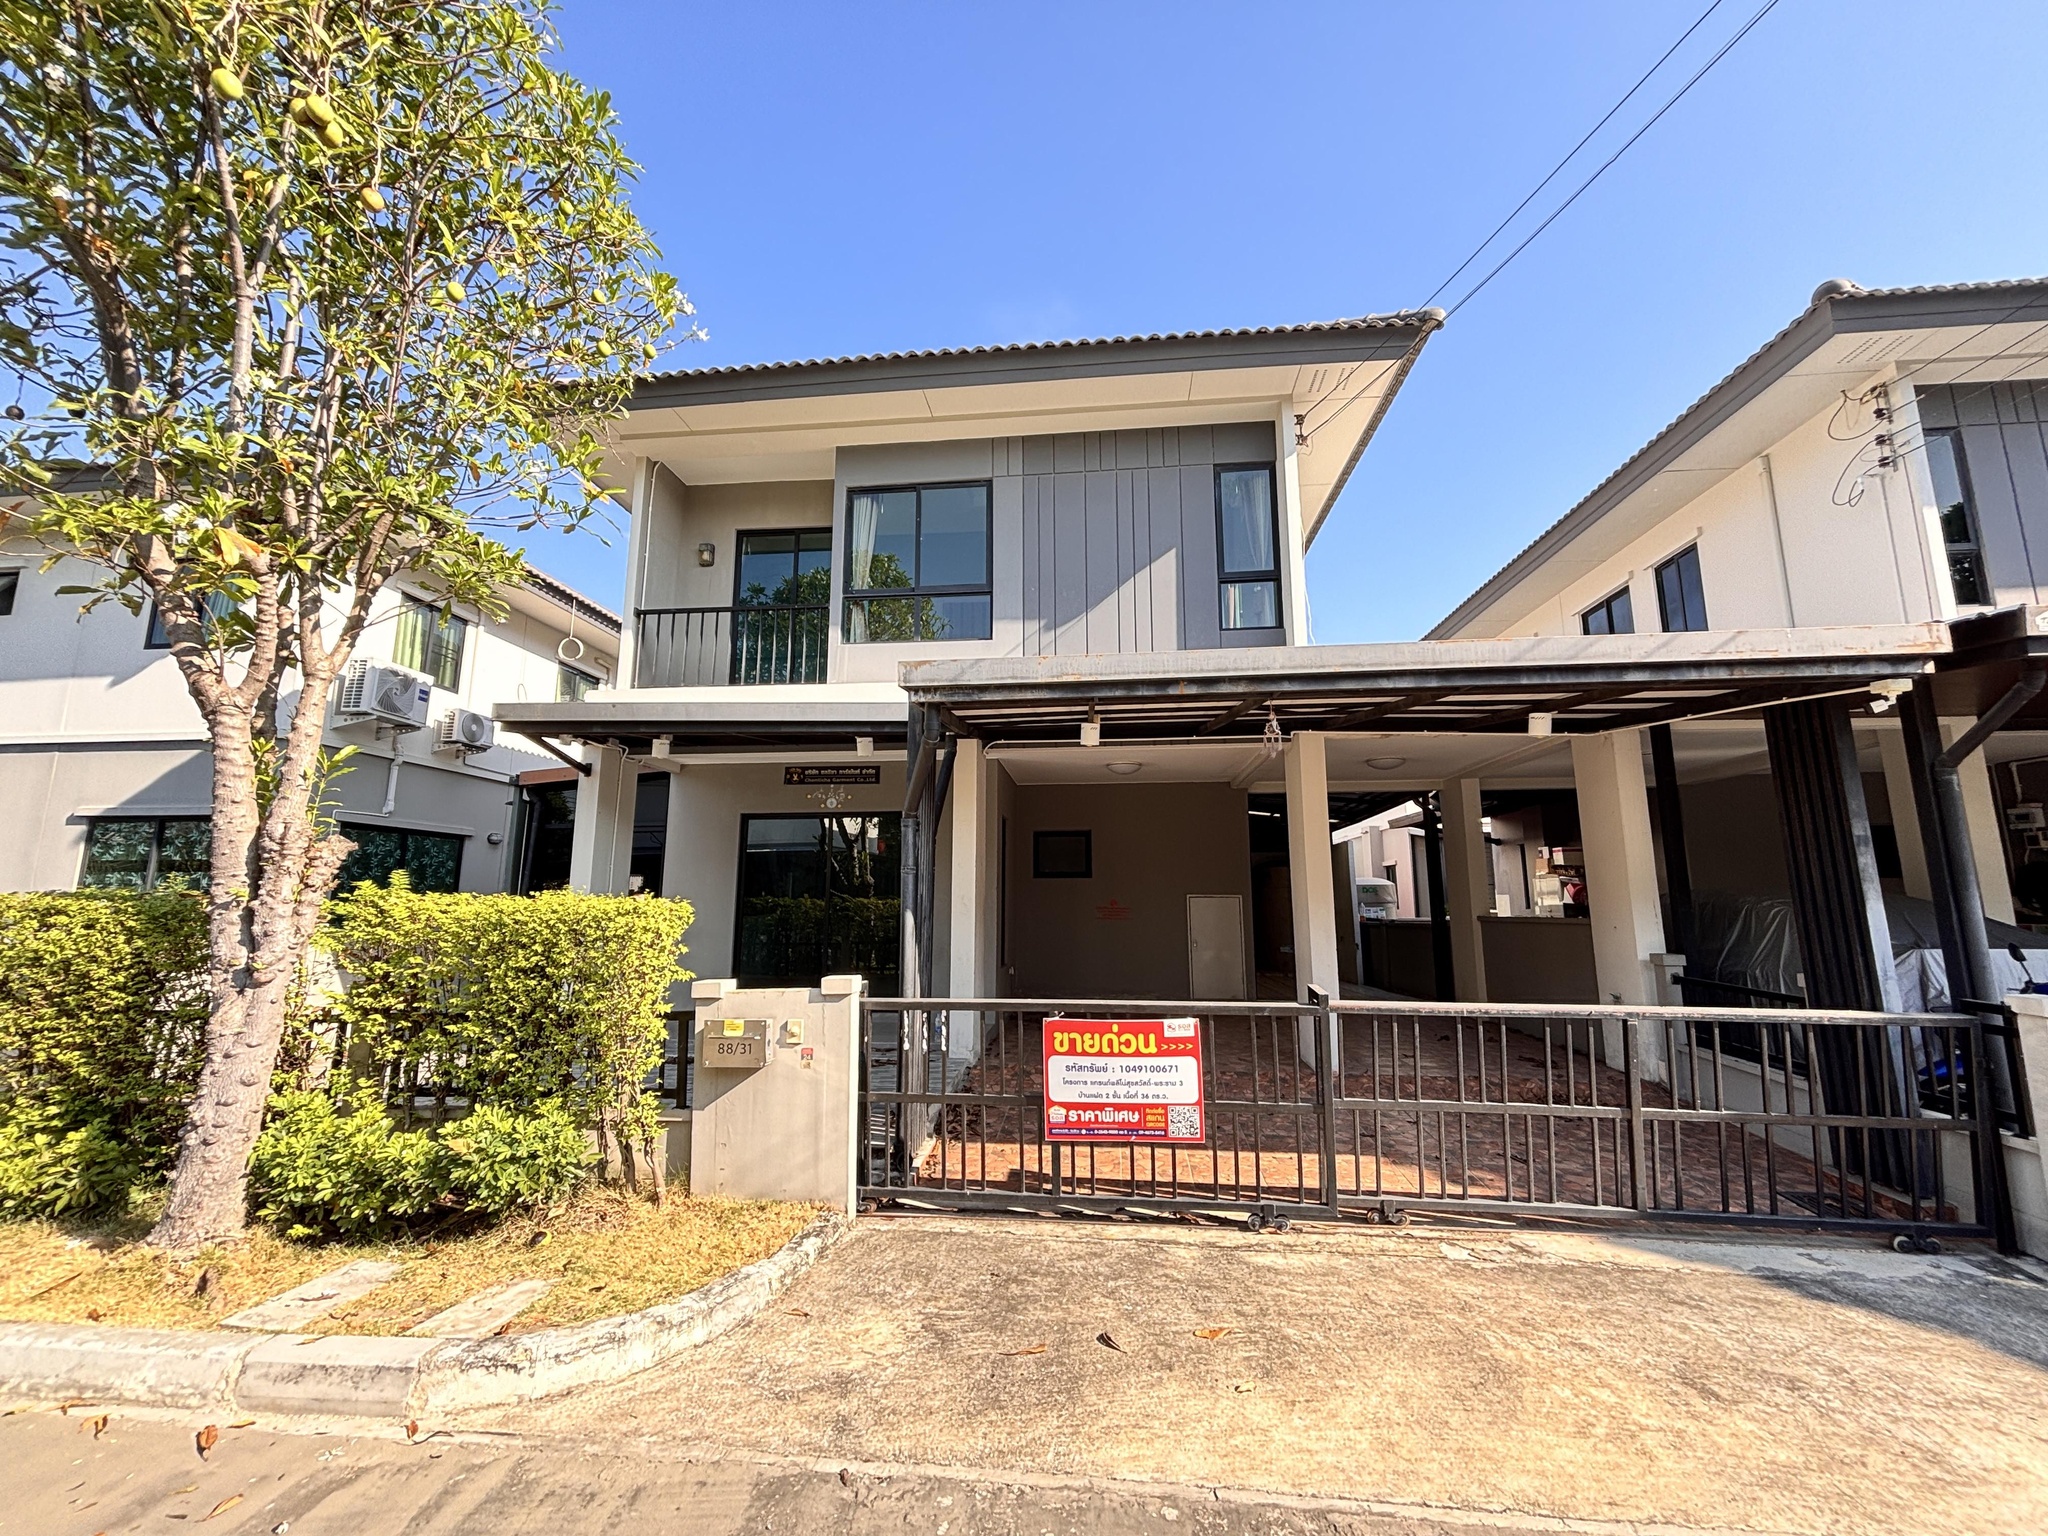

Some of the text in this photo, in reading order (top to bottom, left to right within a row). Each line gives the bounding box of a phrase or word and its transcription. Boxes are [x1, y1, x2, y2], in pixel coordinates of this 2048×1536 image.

[1053, 1023, 1158, 1054] ขายด่วน
[717, 1042, 752, 1056] 88/31
[1065, 1063, 1108, 1073] รหัสทรัพย์
[1119, 1064, 1179, 1073] 1049100671
[1062, 1077, 1088, 1086] โครงการ
[1077, 1090, 1103, 1099] บ้านแฝด
[1111, 1090, 1121, 1099] ชั้น
[1123, 1090, 1138, 1099] เนื้อที่
[1068, 1107, 1140, 1123] ราคาพิเศษ
